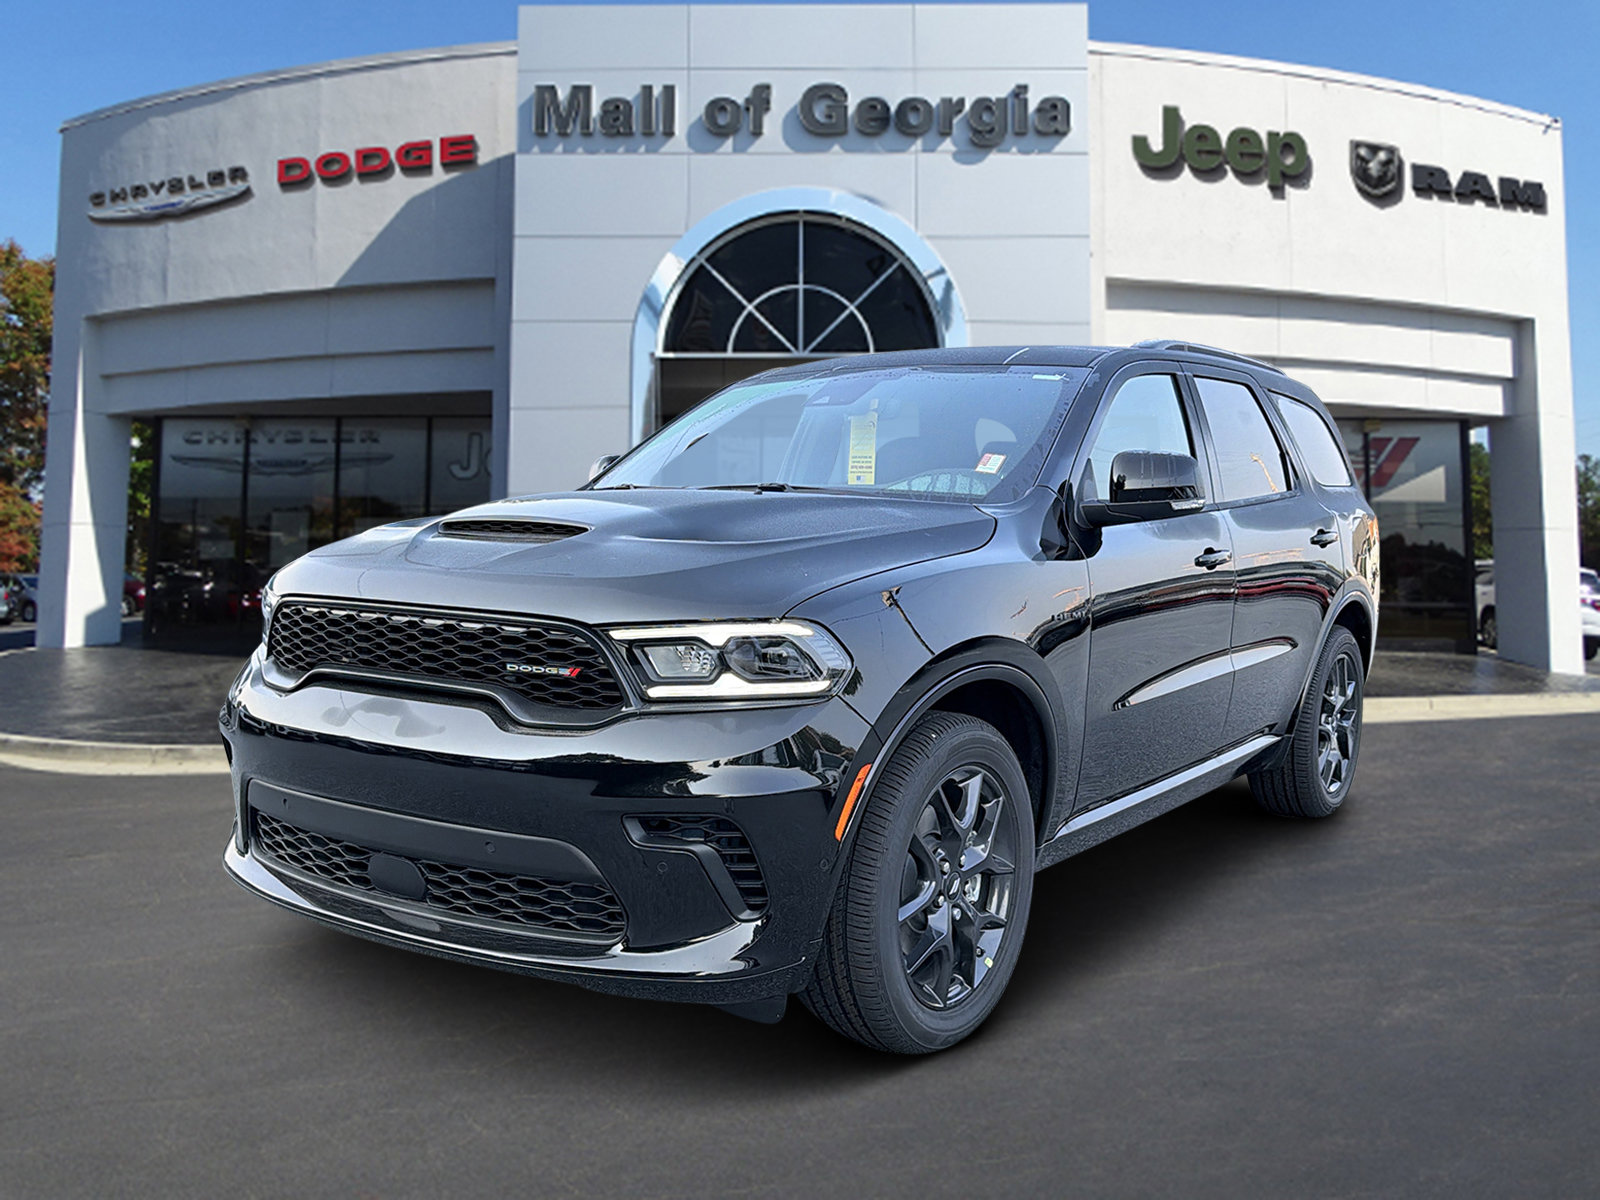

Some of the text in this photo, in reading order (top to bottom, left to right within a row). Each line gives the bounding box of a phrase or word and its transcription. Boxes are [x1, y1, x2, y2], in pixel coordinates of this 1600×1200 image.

[531, 81, 1072, 149] Mall of Georgia
[276, 133, 478, 188] DODGE
[1131, 104, 1309, 190] Jeep
[88, 164, 251, 209] CHRYSLER
[1410, 162, 1547, 213] RAM
[182, 429, 381, 445] CHRYSLER
[505, 662, 572, 676] DODGE
